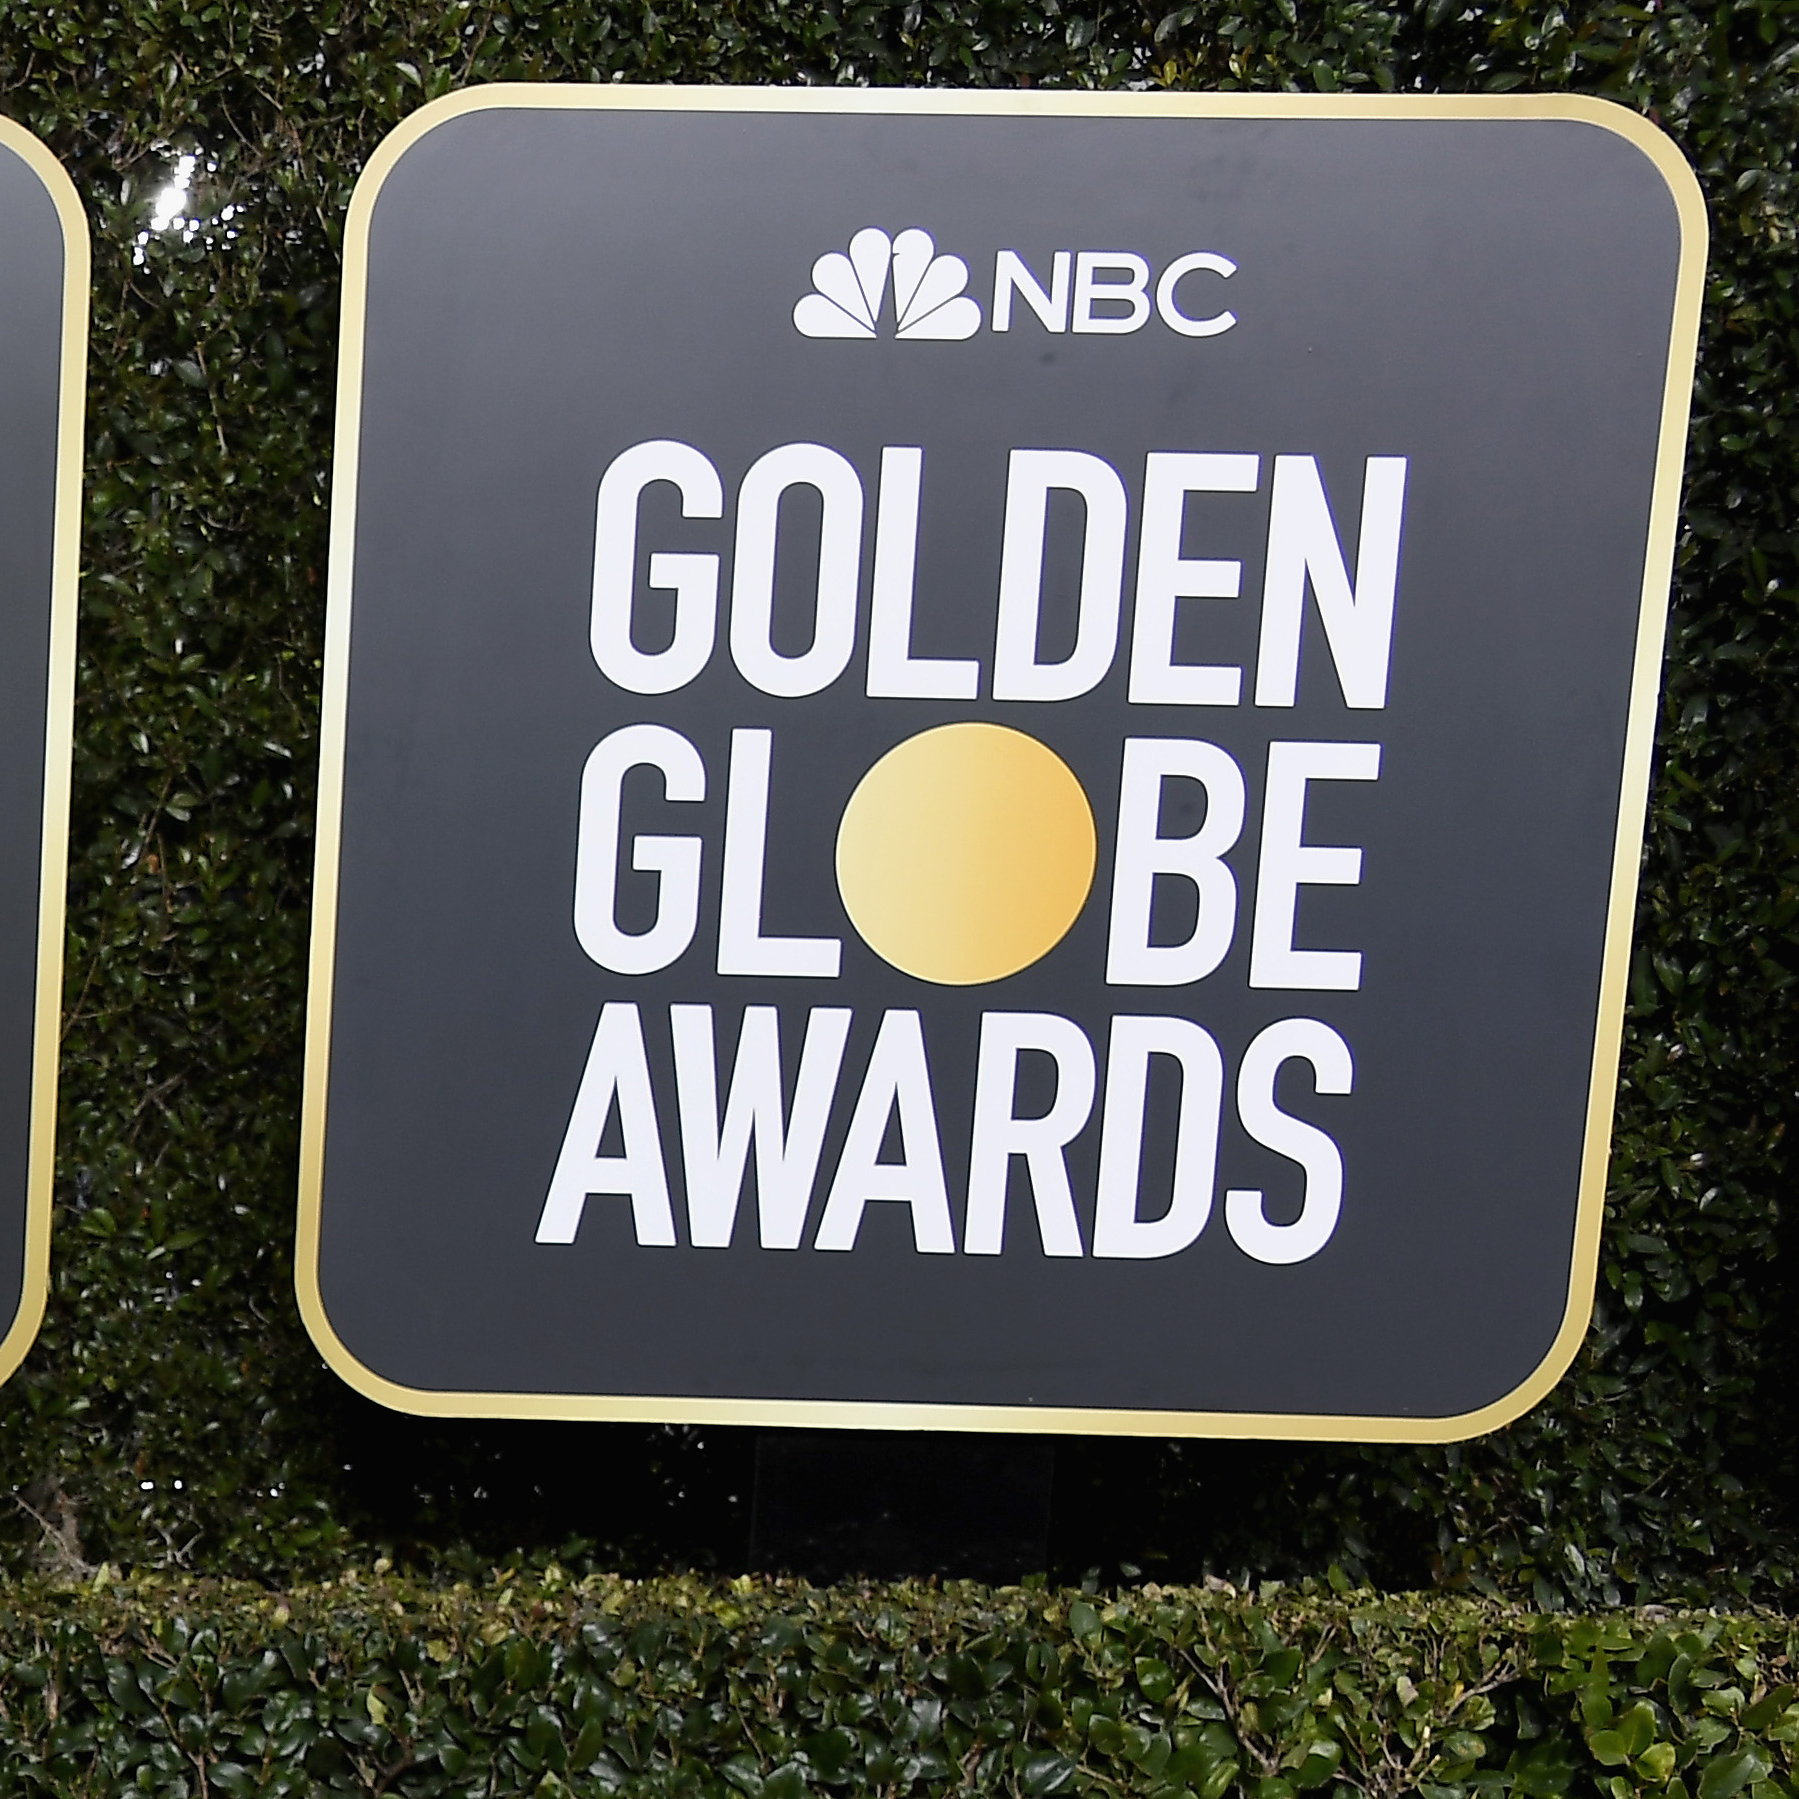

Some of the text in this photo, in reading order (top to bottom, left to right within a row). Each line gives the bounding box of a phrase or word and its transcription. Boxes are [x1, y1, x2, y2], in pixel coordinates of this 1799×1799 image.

[992, 250, 1237, 337] NBC
[590, 440, 1407, 709] GOLDEN
[574, 722, 1381, 991] GLOBE
[535, 1002, 1353, 1264] AWARDS
